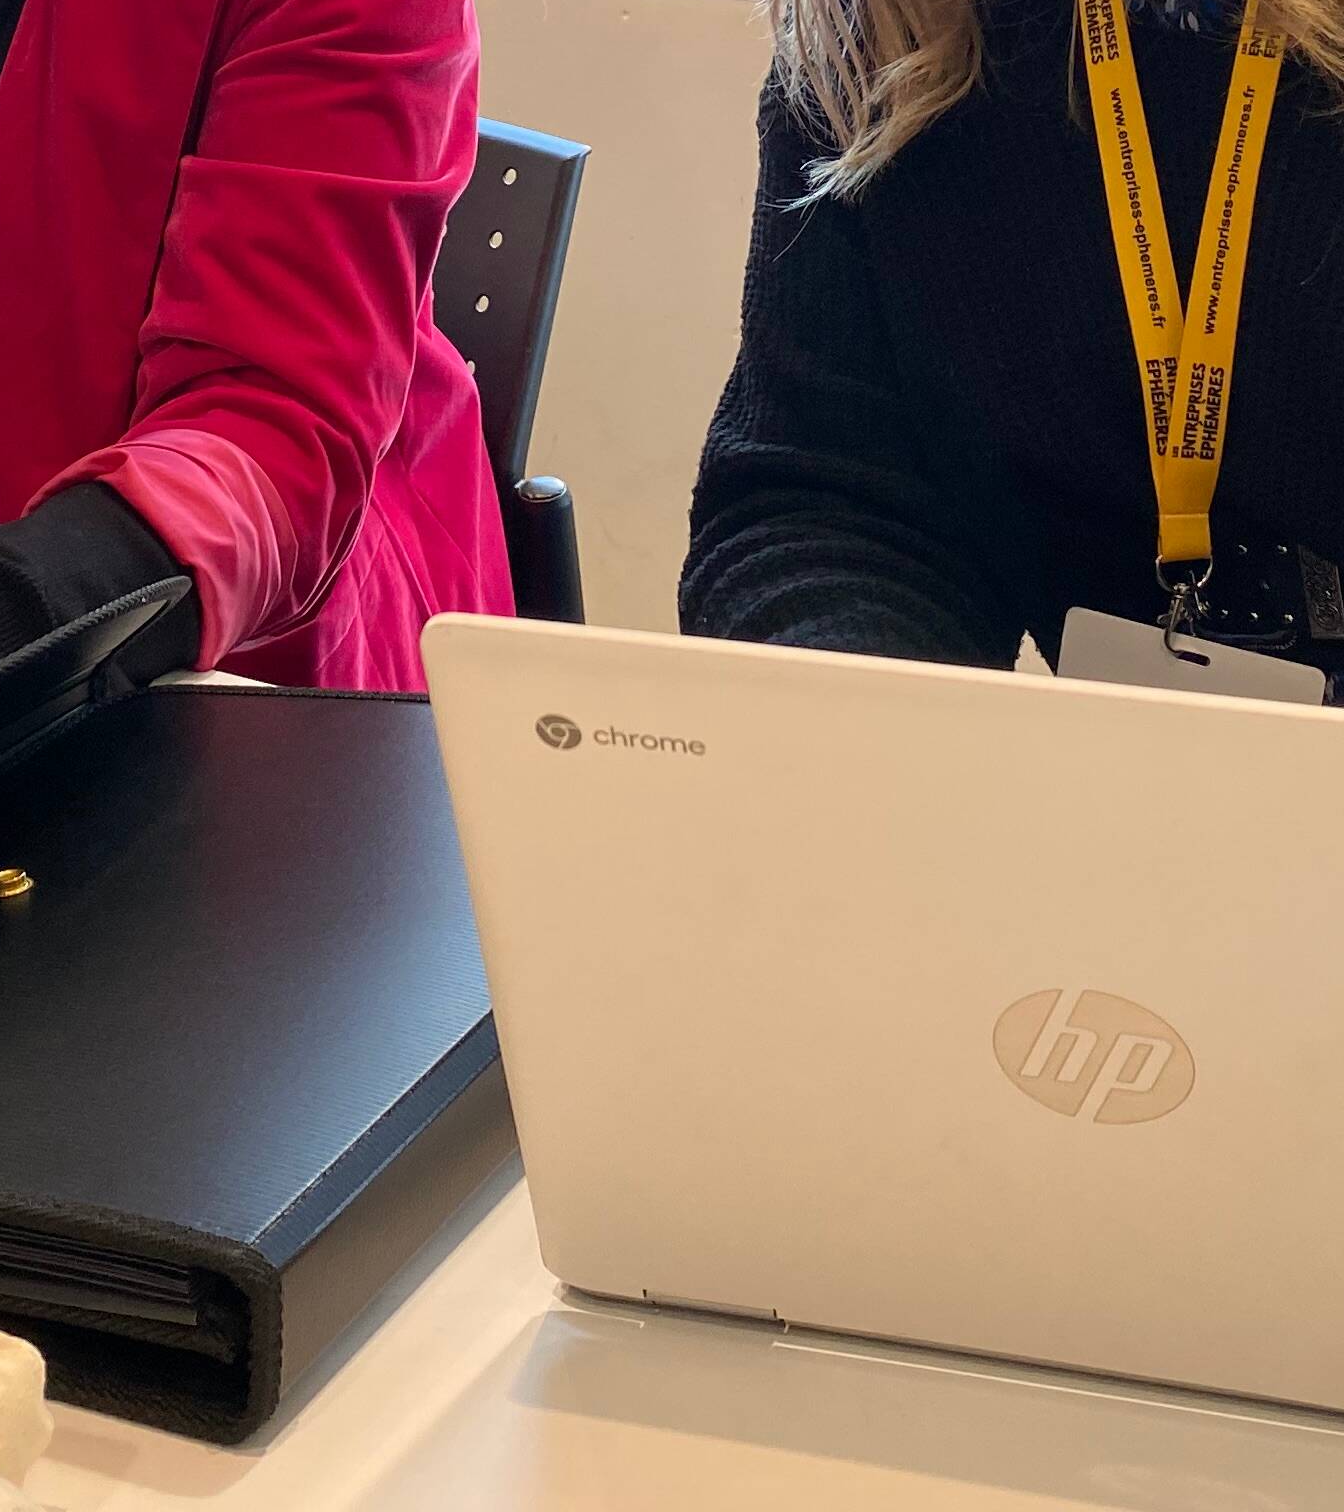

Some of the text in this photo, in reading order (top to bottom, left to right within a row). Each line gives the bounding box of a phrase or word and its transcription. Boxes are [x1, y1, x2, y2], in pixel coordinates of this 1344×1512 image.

[1109, 87, 1165, 330] www.entreprises-ephemeres.fr
[1203, 84, 1257, 335] www.entreprises-ephemeres.fr
[1181, 362, 1206, 459] ENTREPRISES
[592, 725, 706, 757] chrome
[1017, 988, 1176, 1124] hp
